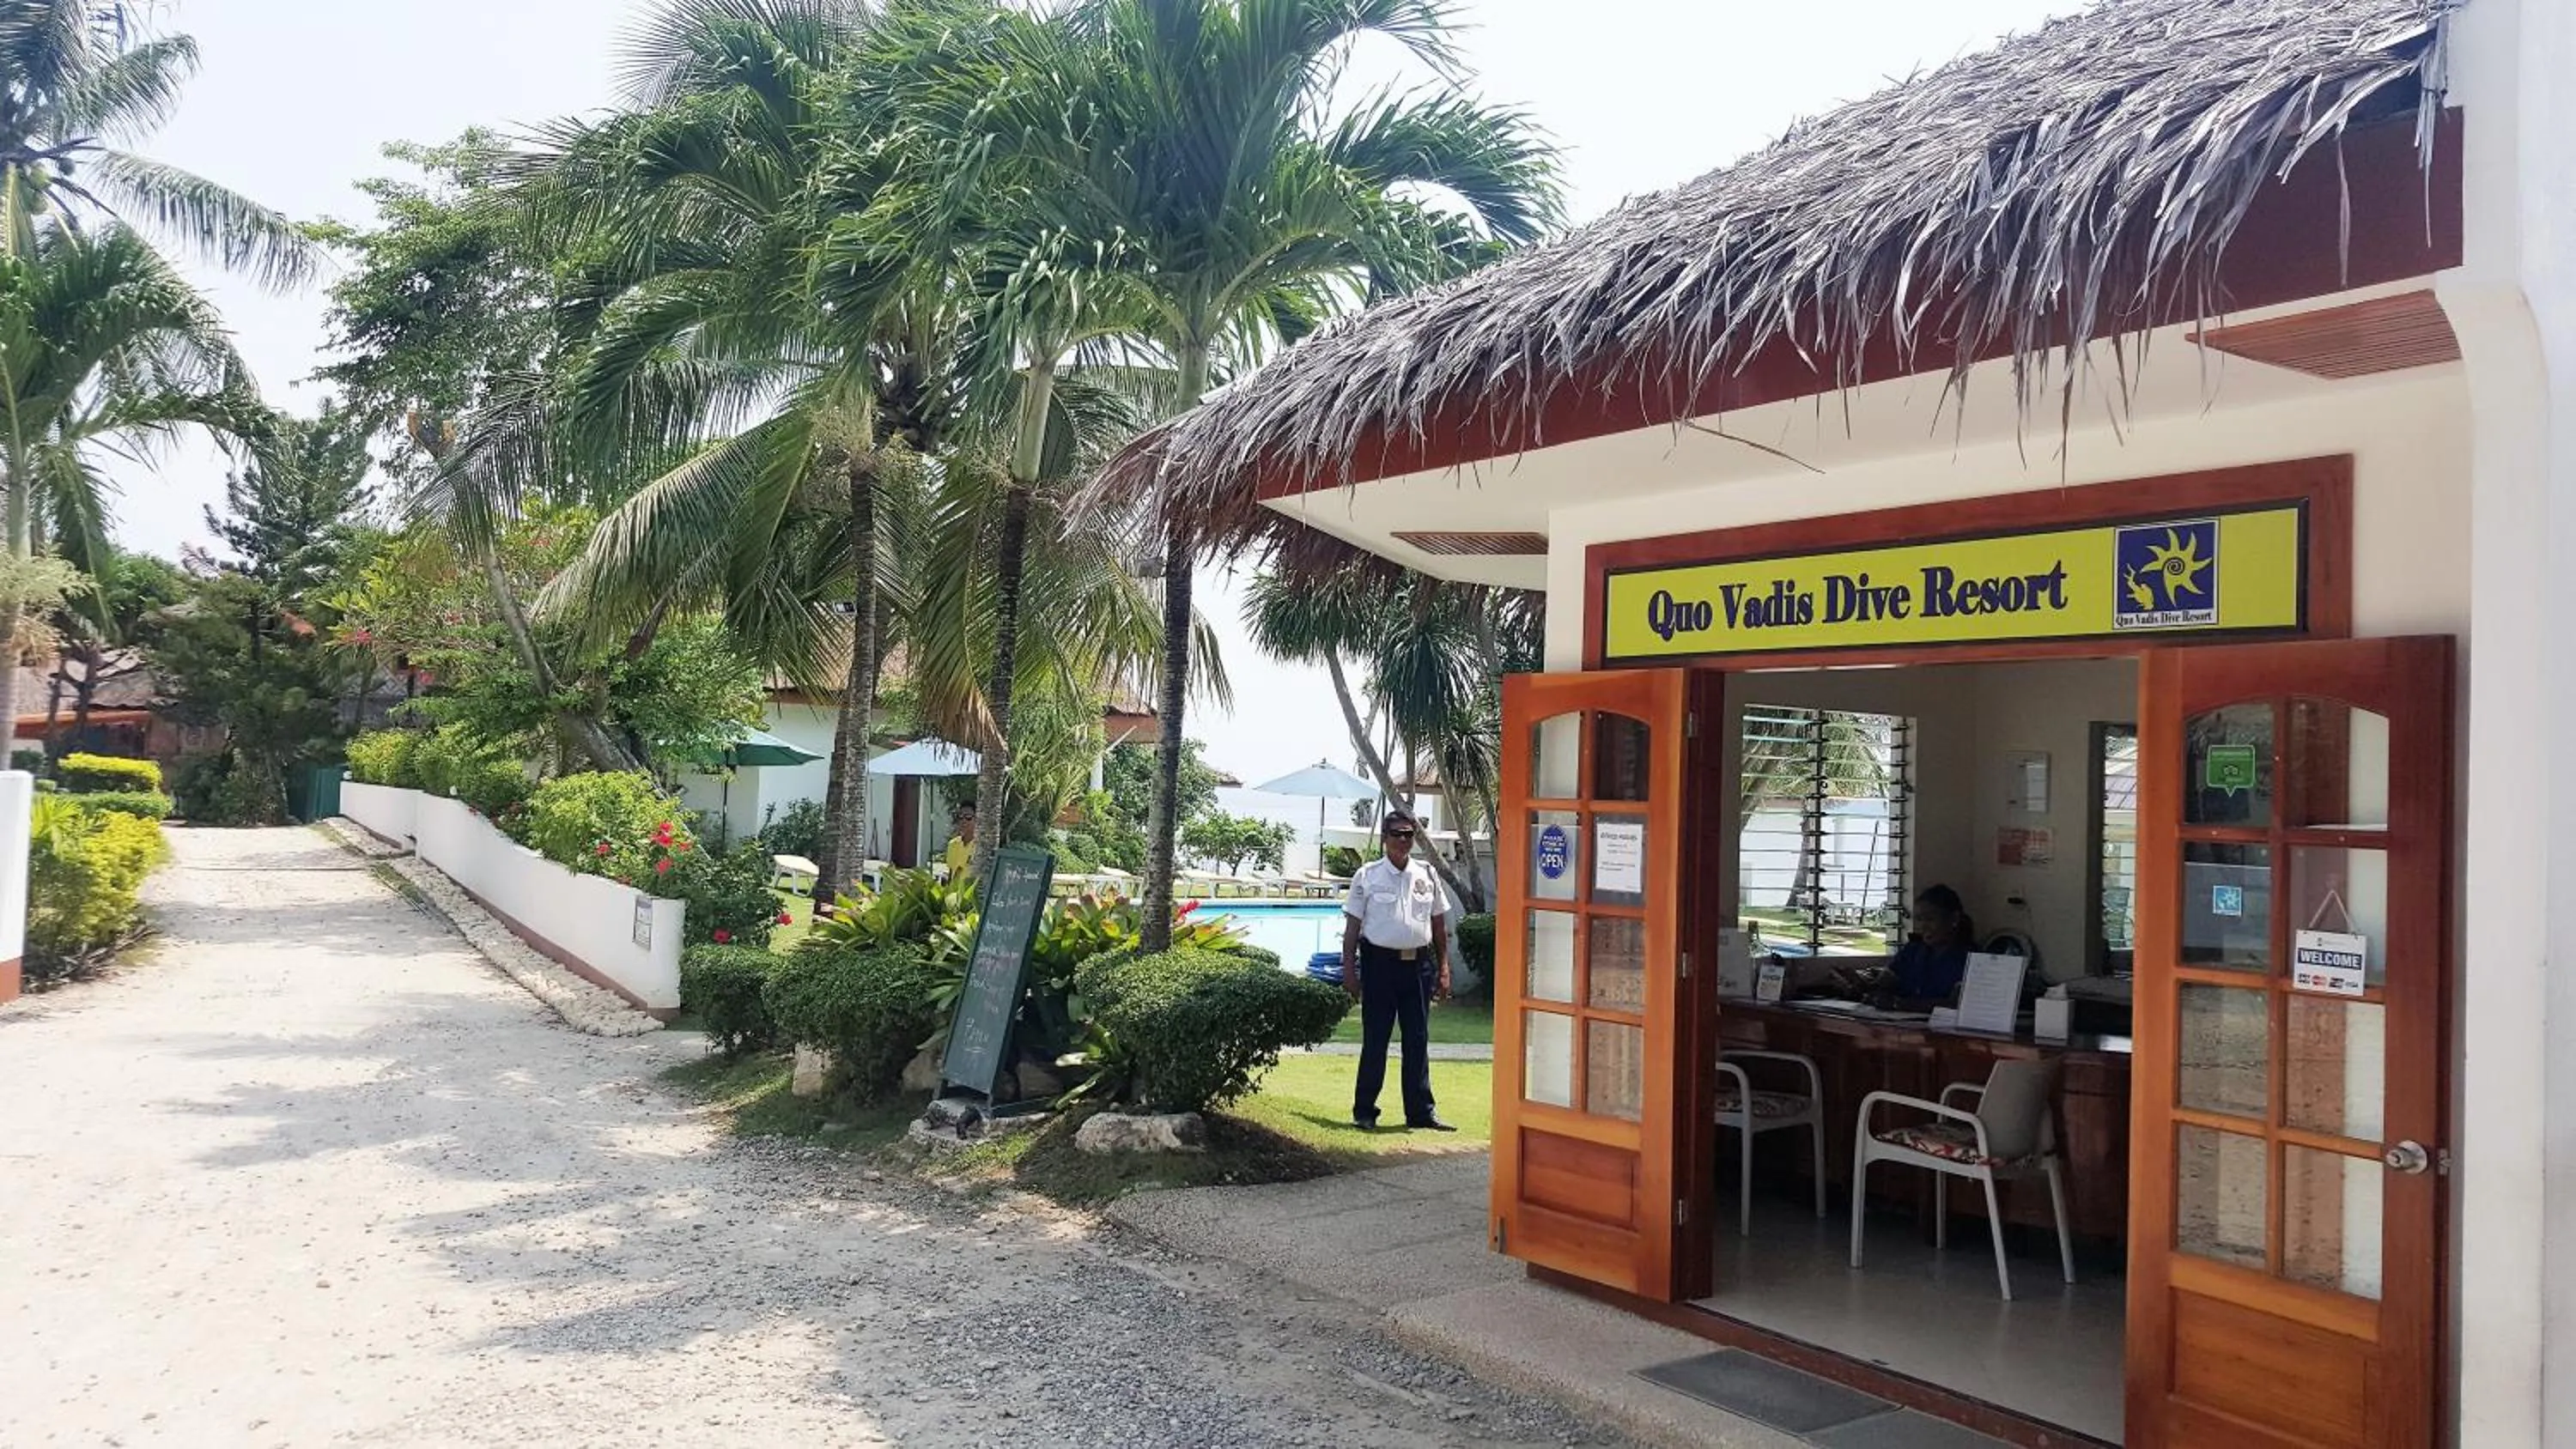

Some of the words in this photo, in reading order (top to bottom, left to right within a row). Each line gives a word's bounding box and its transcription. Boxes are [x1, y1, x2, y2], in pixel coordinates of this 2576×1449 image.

[1648, 590, 1713, 641] Quo
[1718, 579, 1814, 628] Vadis
[1822, 575, 1911, 623] Dive
[1919, 559, 2069, 617] Resort
[1541, 853, 1564, 868] OPEN
[2301, 950, 2360, 967] WELCOME
